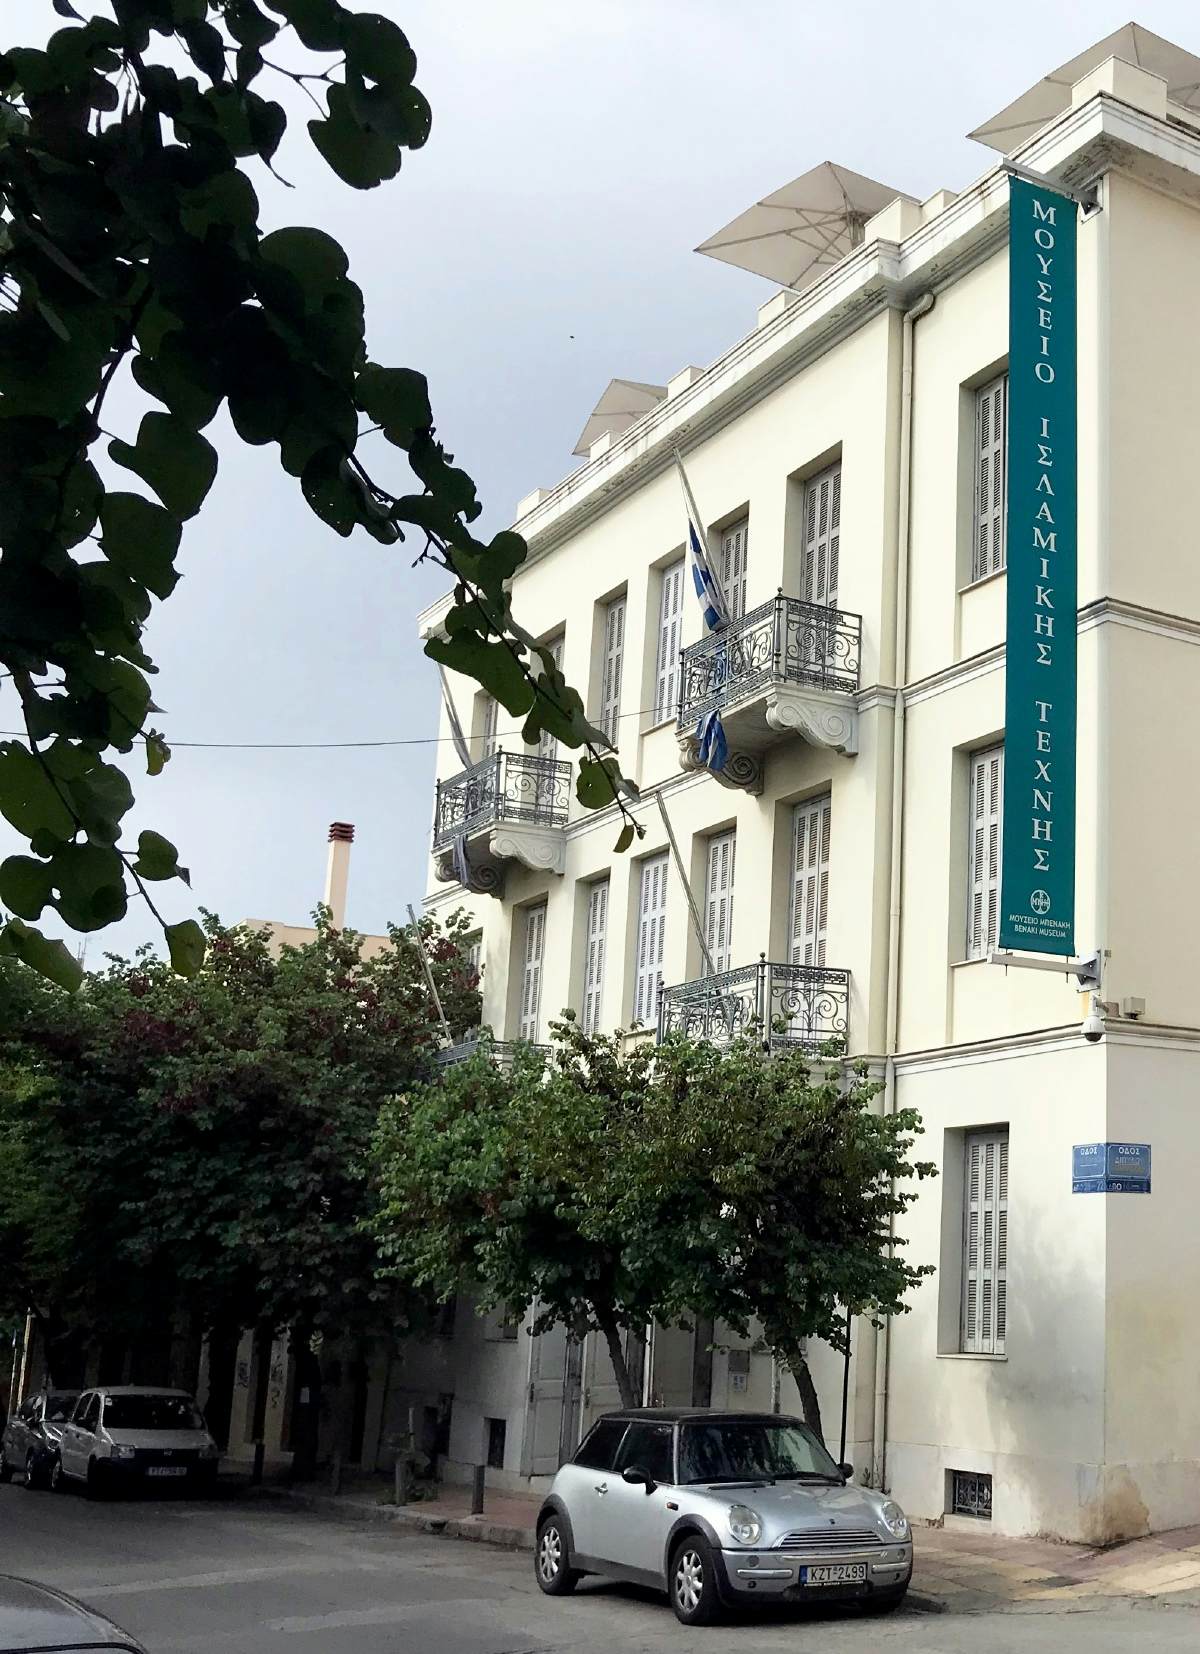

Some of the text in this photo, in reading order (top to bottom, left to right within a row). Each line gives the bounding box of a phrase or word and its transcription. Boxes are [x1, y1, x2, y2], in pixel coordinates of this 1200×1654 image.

[1031, 199, 1057, 872] ΜΟΥΣΕΙΟ ΙΣΛΑΜΙΚΗΣ ΤΕΧΝΗΣ
[1009, 914, 1071, 929] ΜΟΥΣΕΙΟ ΜΠΕΝΑΚΗ
[1014, 924, 1067, 938] BENAKI MUSEUM
[1118, 1146, 1141, 1156] ΟΔΟΣ
